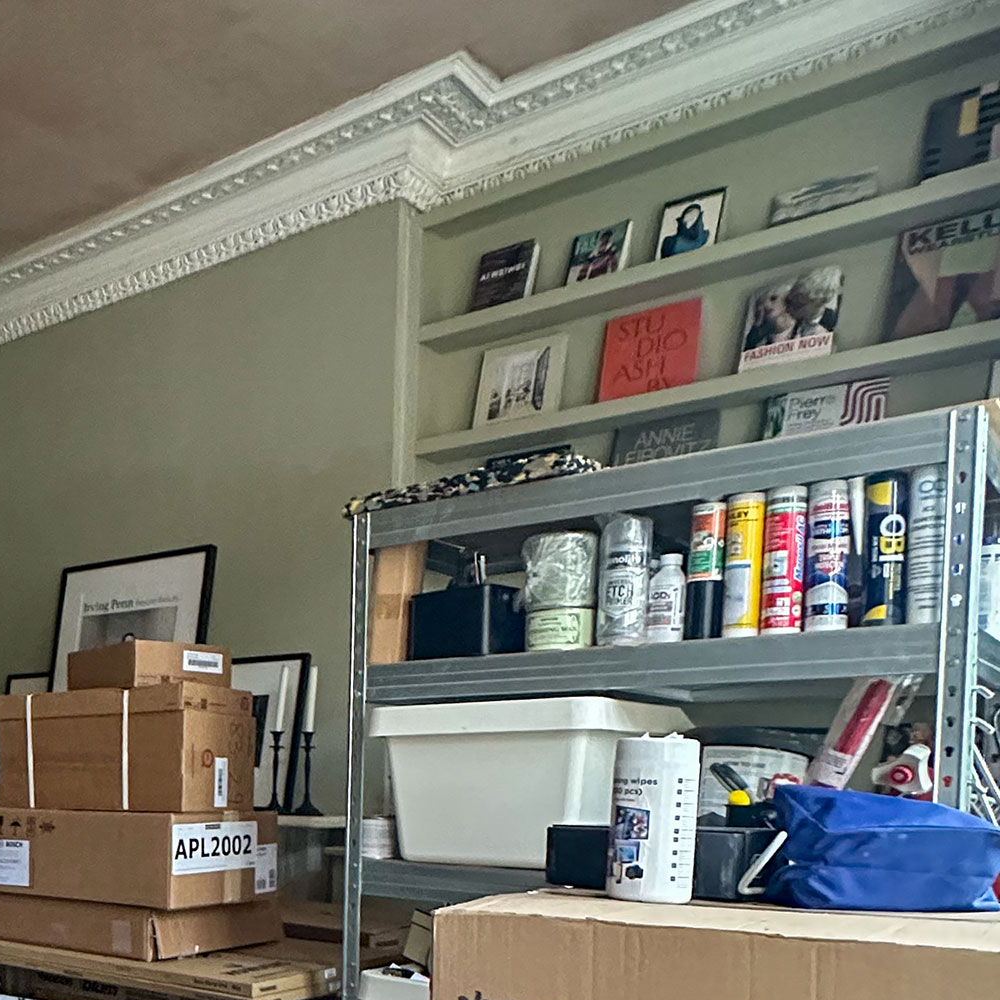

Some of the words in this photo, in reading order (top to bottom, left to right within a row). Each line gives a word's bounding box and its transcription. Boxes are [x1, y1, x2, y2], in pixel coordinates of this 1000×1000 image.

[637, 329, 688, 358] DIO
[744, 341, 793, 362] FASHION
[798, 335, 830, 349] NOW
[613, 356, 666, 383] ASH
[634, 422, 695, 450] ANNIE
[624, 787, 643, 796] pcs)
[631, 777, 658, 786] wipes
[174, 834, 252, 860] APL2002
